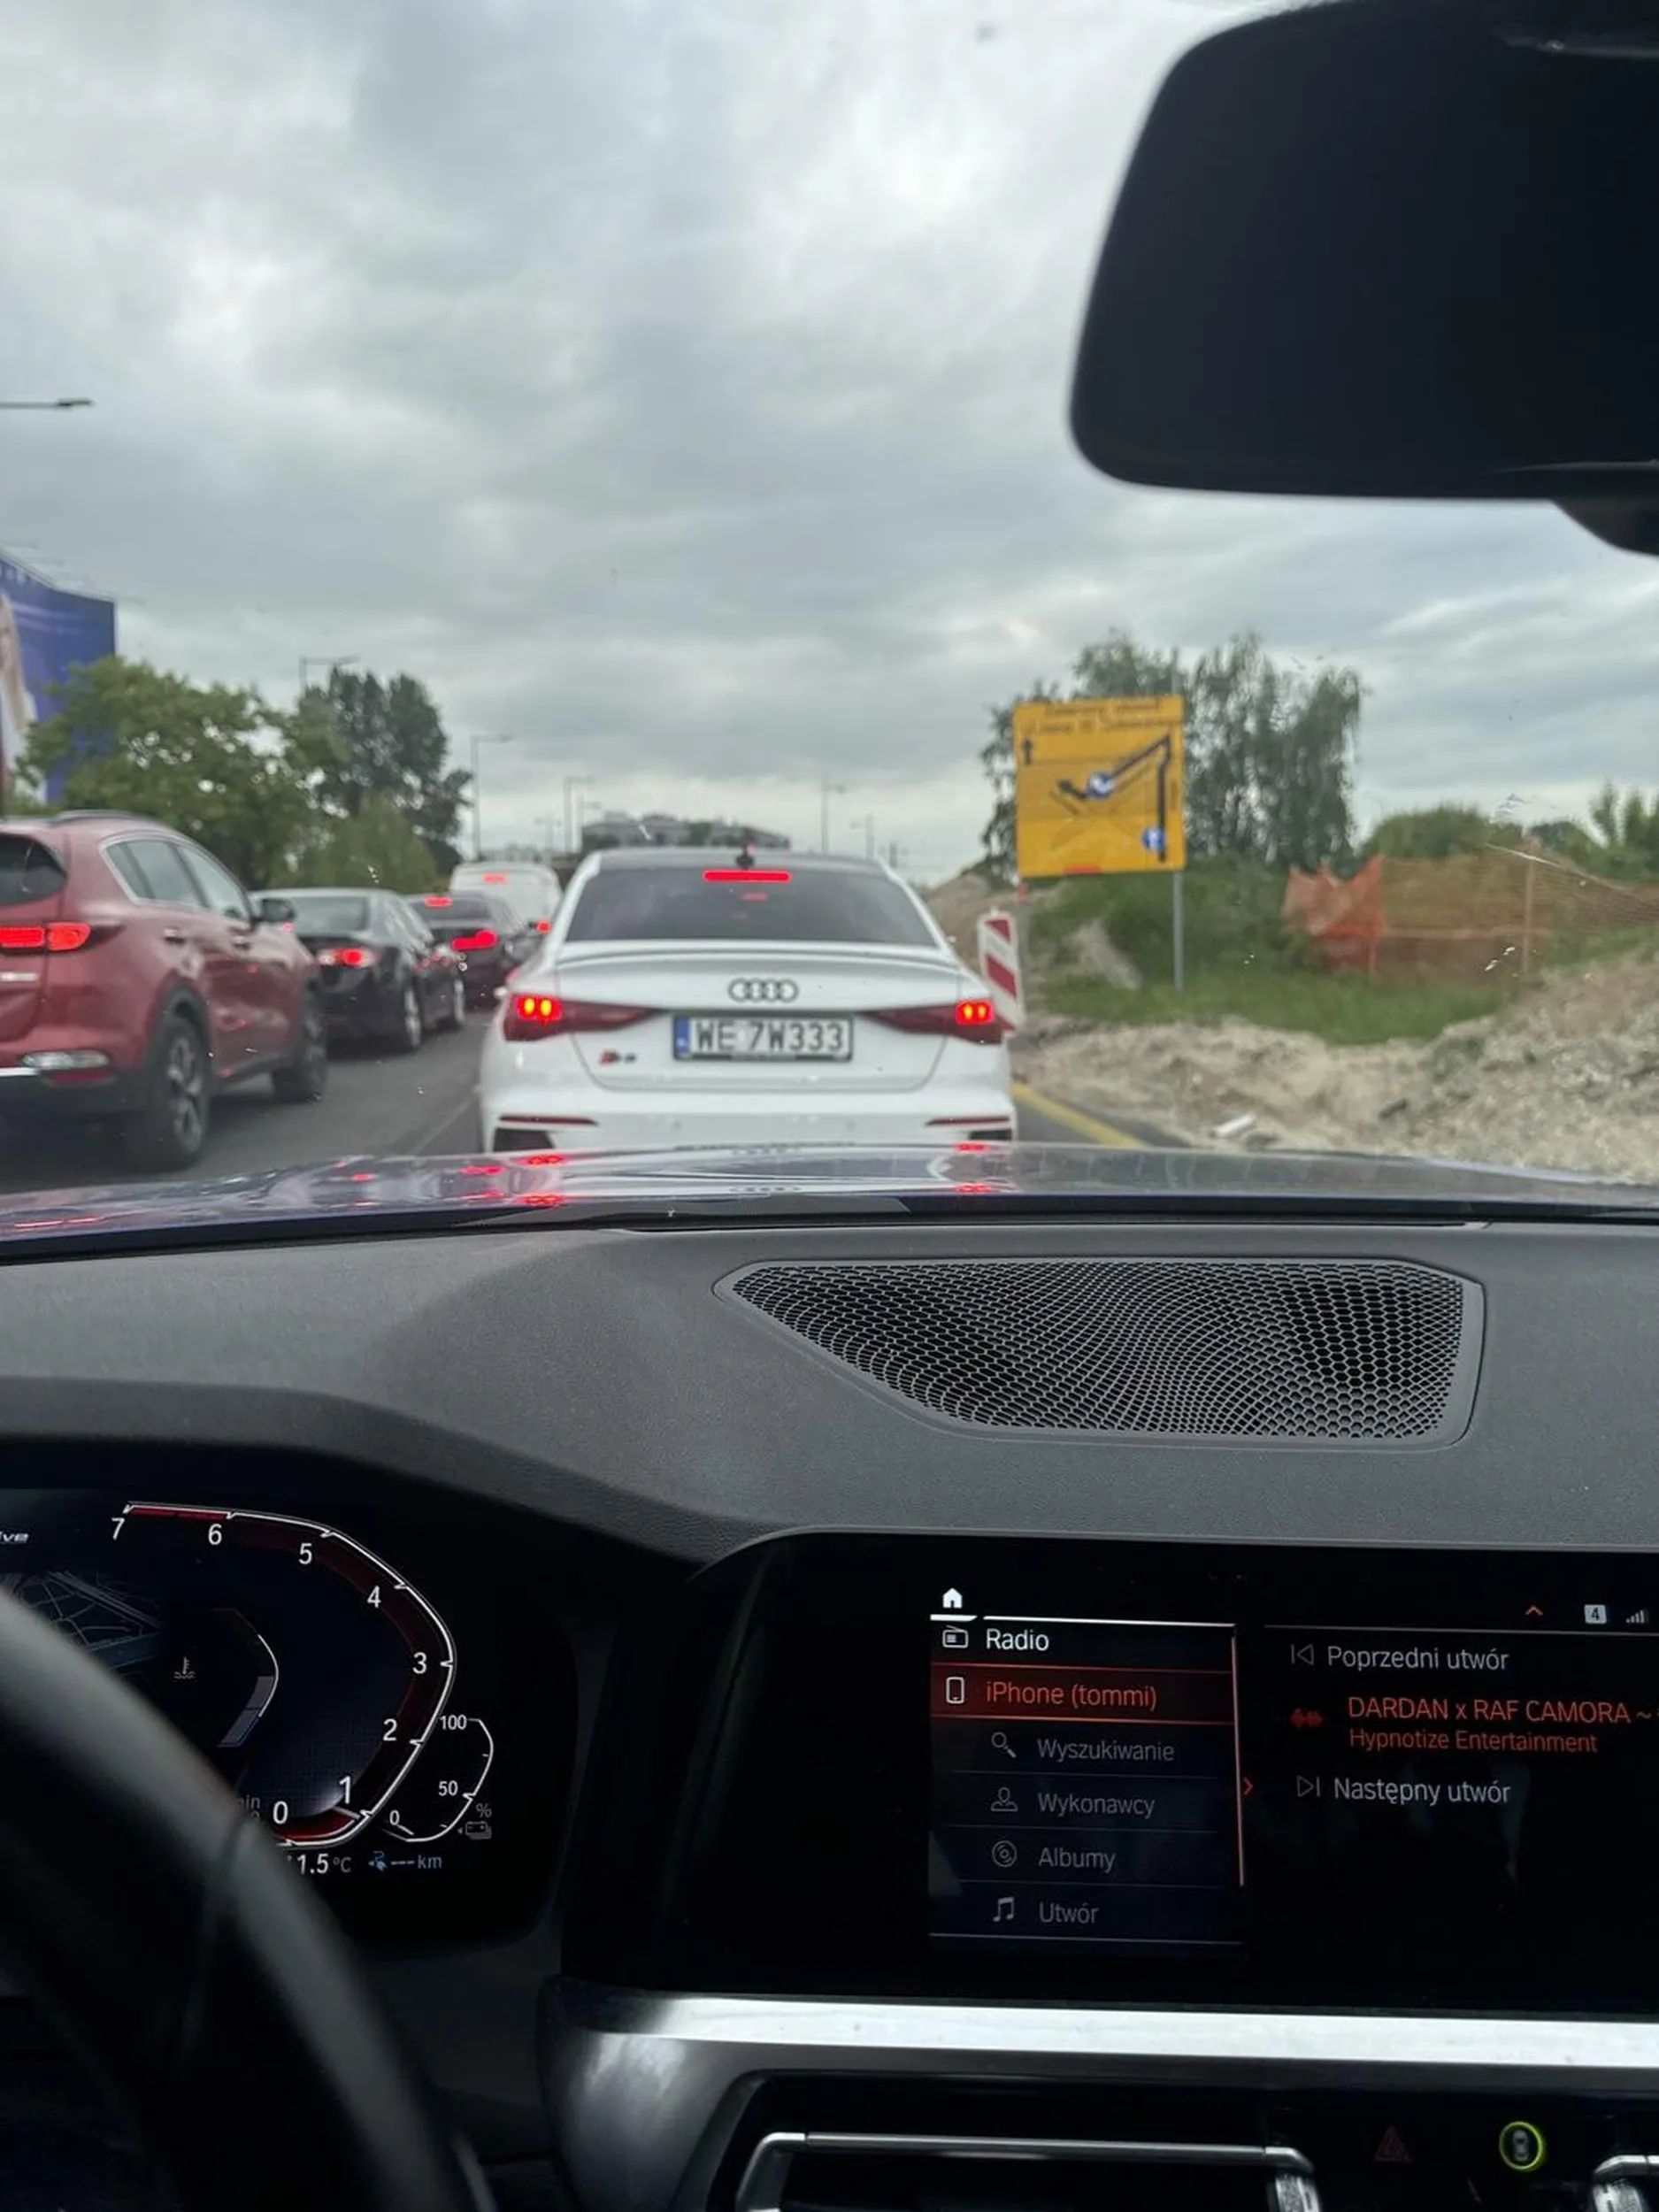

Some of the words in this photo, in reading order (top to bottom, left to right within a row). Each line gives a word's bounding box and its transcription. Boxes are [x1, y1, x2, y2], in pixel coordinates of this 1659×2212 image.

[696, 1022, 735, 1050] WE
[751, 1022, 844, 1050] 7W333
[111, 1517, 125, 1540] 7
[208, 1524, 222, 1544] 6
[298, 1543, 312, 1563] 5
[367, 1586, 380, 1608] 4
[986, 1628, 1049, 1651] Radio
[413, 1653, 426, 1674] 3
[1327, 1645, 1440, 1671] Poprzedni
[1447, 1649, 1509, 1670] utwór
[986, 1680, 1064, 1705] iPhone
[1071, 1685, 1157, 1711] (tommi)
[1348, 1696, 1448, 1720] DARDAN
[1455, 1703, 1468, 1720] x
[1473, 1698, 1519, 1721] RAF
[1525, 1701, 1632, 1724] CAMORA
[382, 1719, 396, 1741] 2
[441, 1714, 467, 1731] 100
[1037, 1739, 1175, 1762] Wyszukiwanie
[1348, 1728, 1450, 1751] Hypnotize
[1455, 1731, 1599, 1753] Entertainment
[339, 1776, 351, 1804] 1
[438, 1780, 458, 1796] 50
[1333, 1778, 1440, 1806] Następny
[1448, 1782, 1511, 1803] utwór
[273, 1801, 289, 1824] 0
[1038, 1793, 1155, 1817] Wykonawcy
[389, 1810, 400, 1825] 0
[288, 1854, 329, 1875] 1.5
[1038, 1847, 1116, 1873] Albumy
[1039, 1901, 1098, 1924] Utwór
